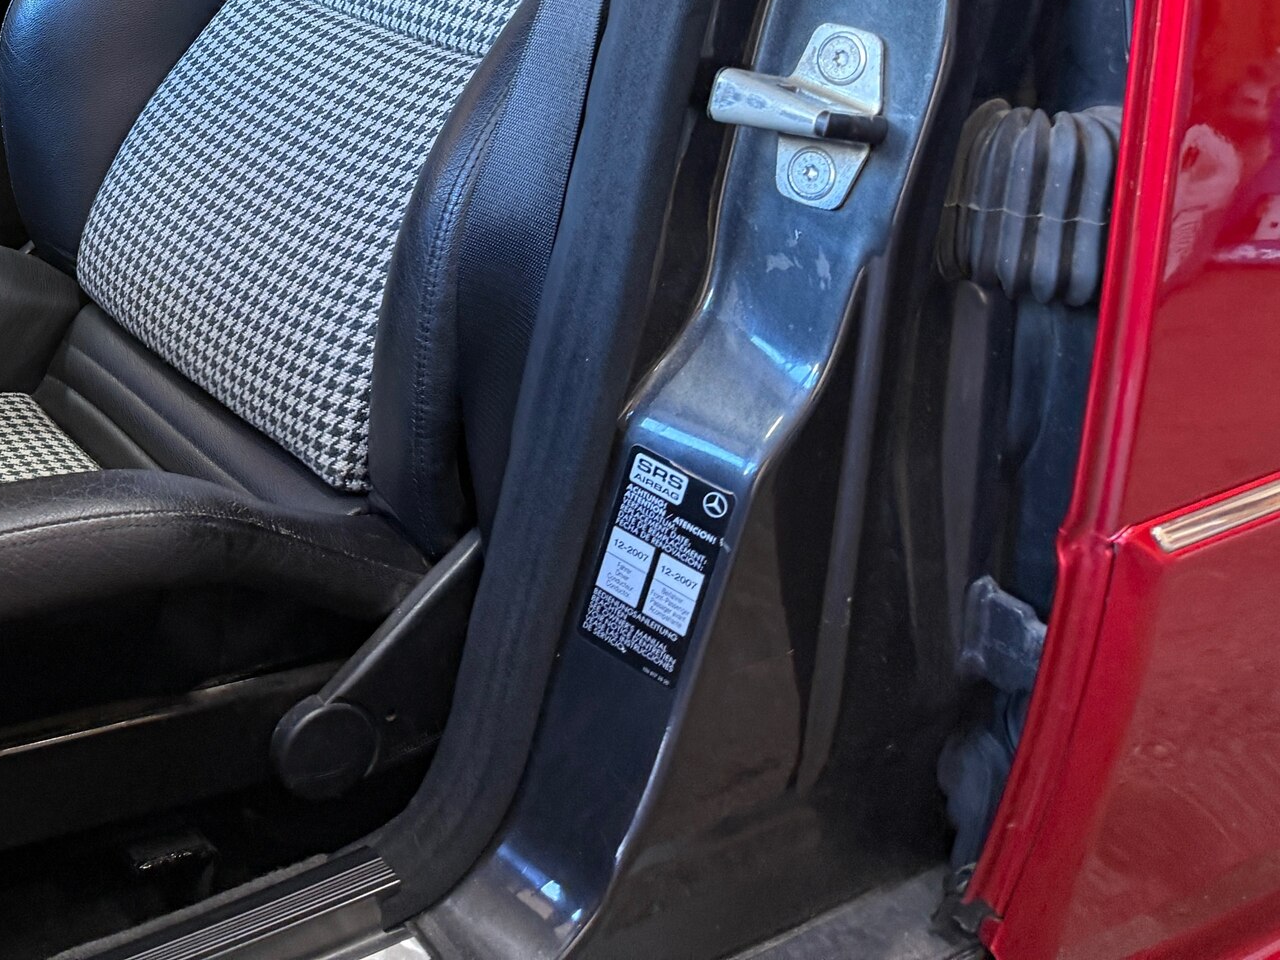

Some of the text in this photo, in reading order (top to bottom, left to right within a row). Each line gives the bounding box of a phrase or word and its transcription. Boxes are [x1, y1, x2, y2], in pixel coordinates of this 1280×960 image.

[633, 473, 679, 501] AIRBAG
[636, 459, 683, 490] SRS
[623, 489, 666, 517] ATTENTION
[636, 520, 648, 532] DE
[639, 530, 650, 541] DE
[613, 538, 648, 563] 12-2007
[660, 565, 697, 591] 12-2007
[582, 621, 592, 632] DE
